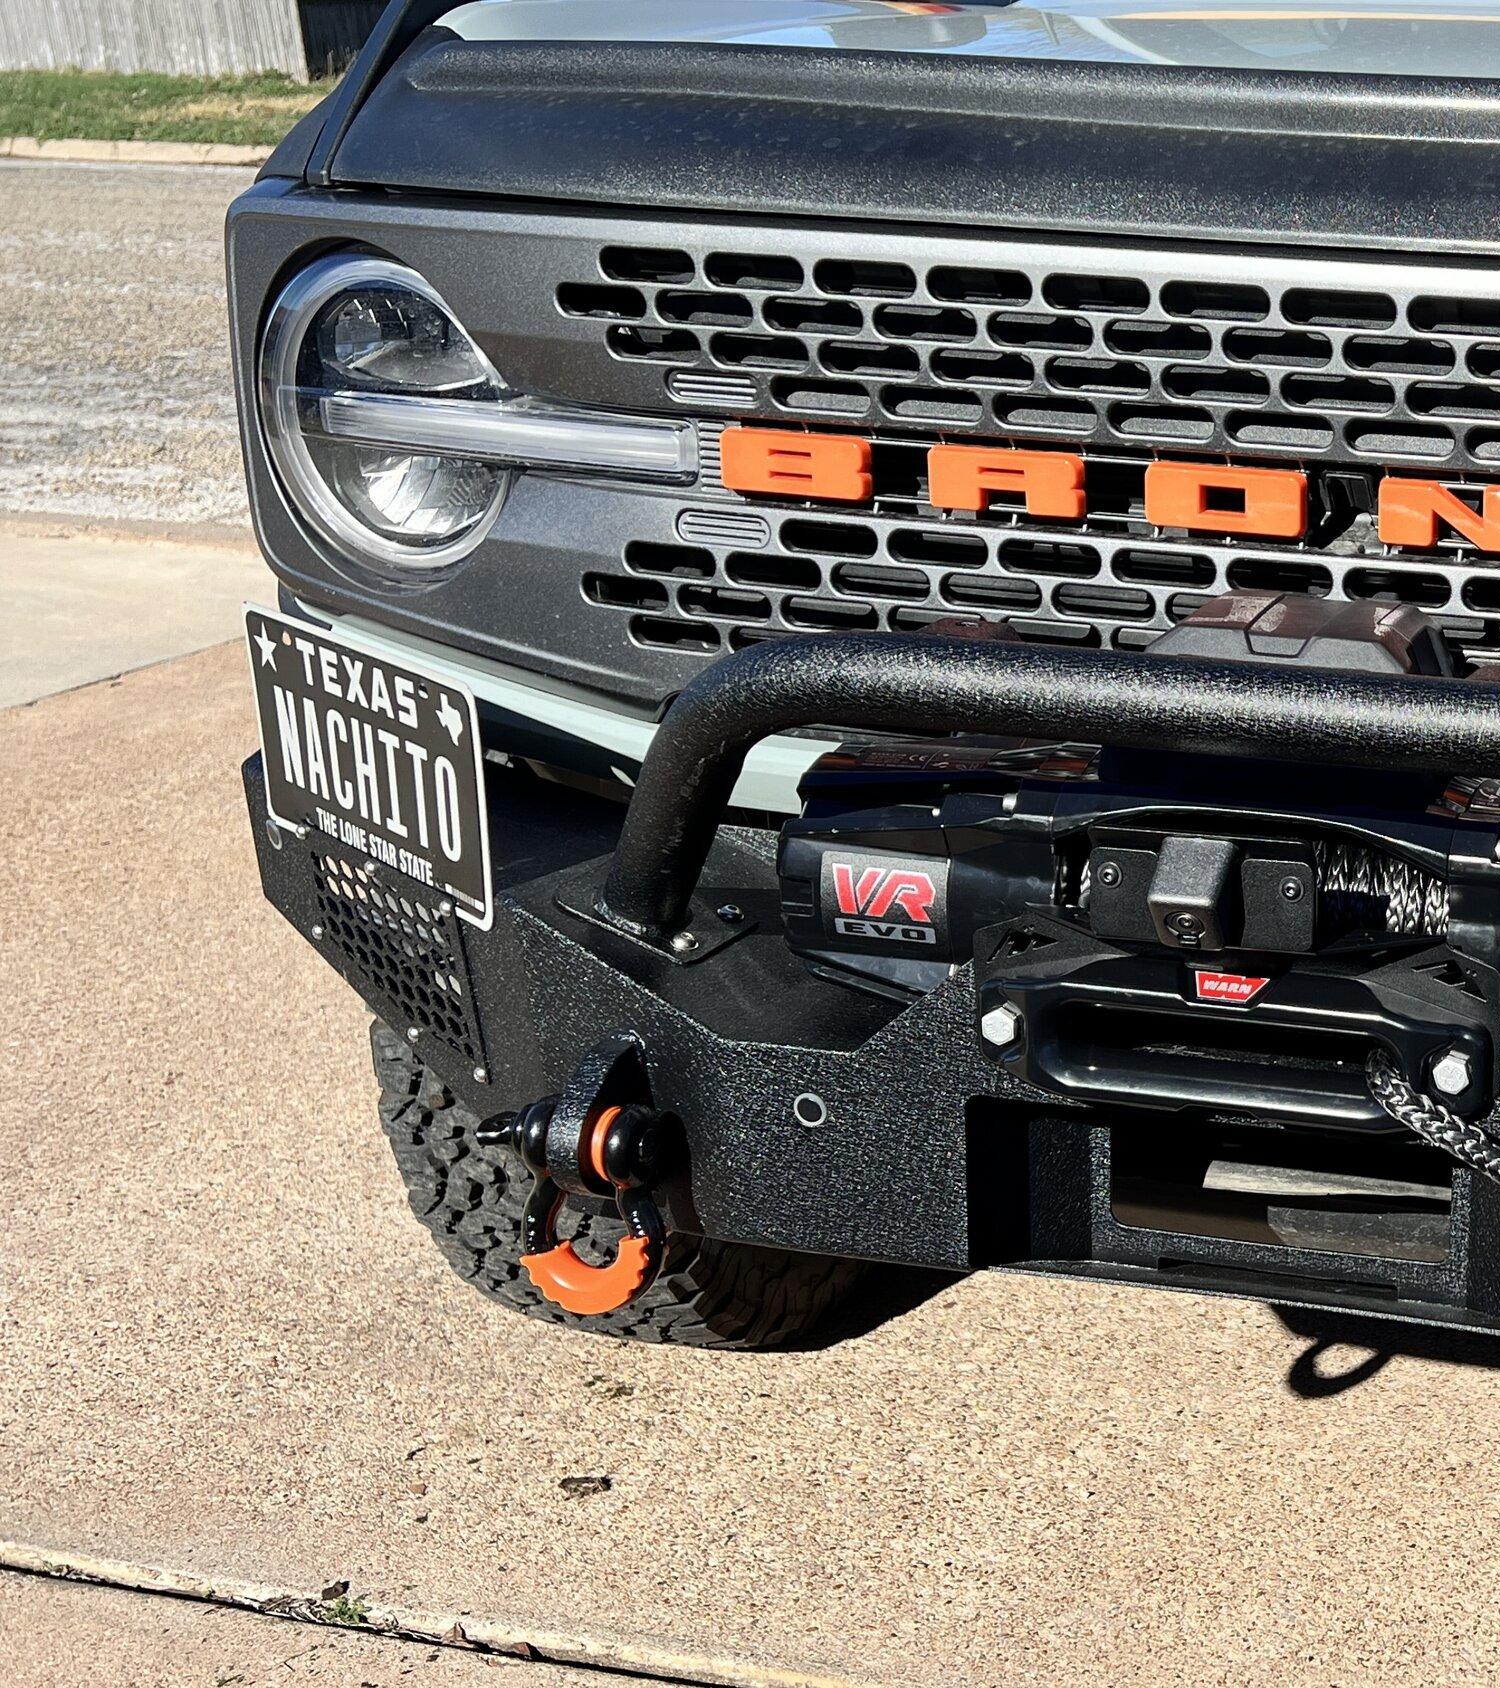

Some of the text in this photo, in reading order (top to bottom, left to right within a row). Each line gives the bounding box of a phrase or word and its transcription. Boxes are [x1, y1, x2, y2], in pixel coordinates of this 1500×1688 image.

[295, 637, 419, 729] TEXAS
[273, 685, 462, 863] NACHITO
[315, 806, 434, 888] THE LONE STAR STATE
[832, 863, 937, 923] VR
[843, 921, 926, 940] EVO
[1203, 980, 1252, 994] WARN
